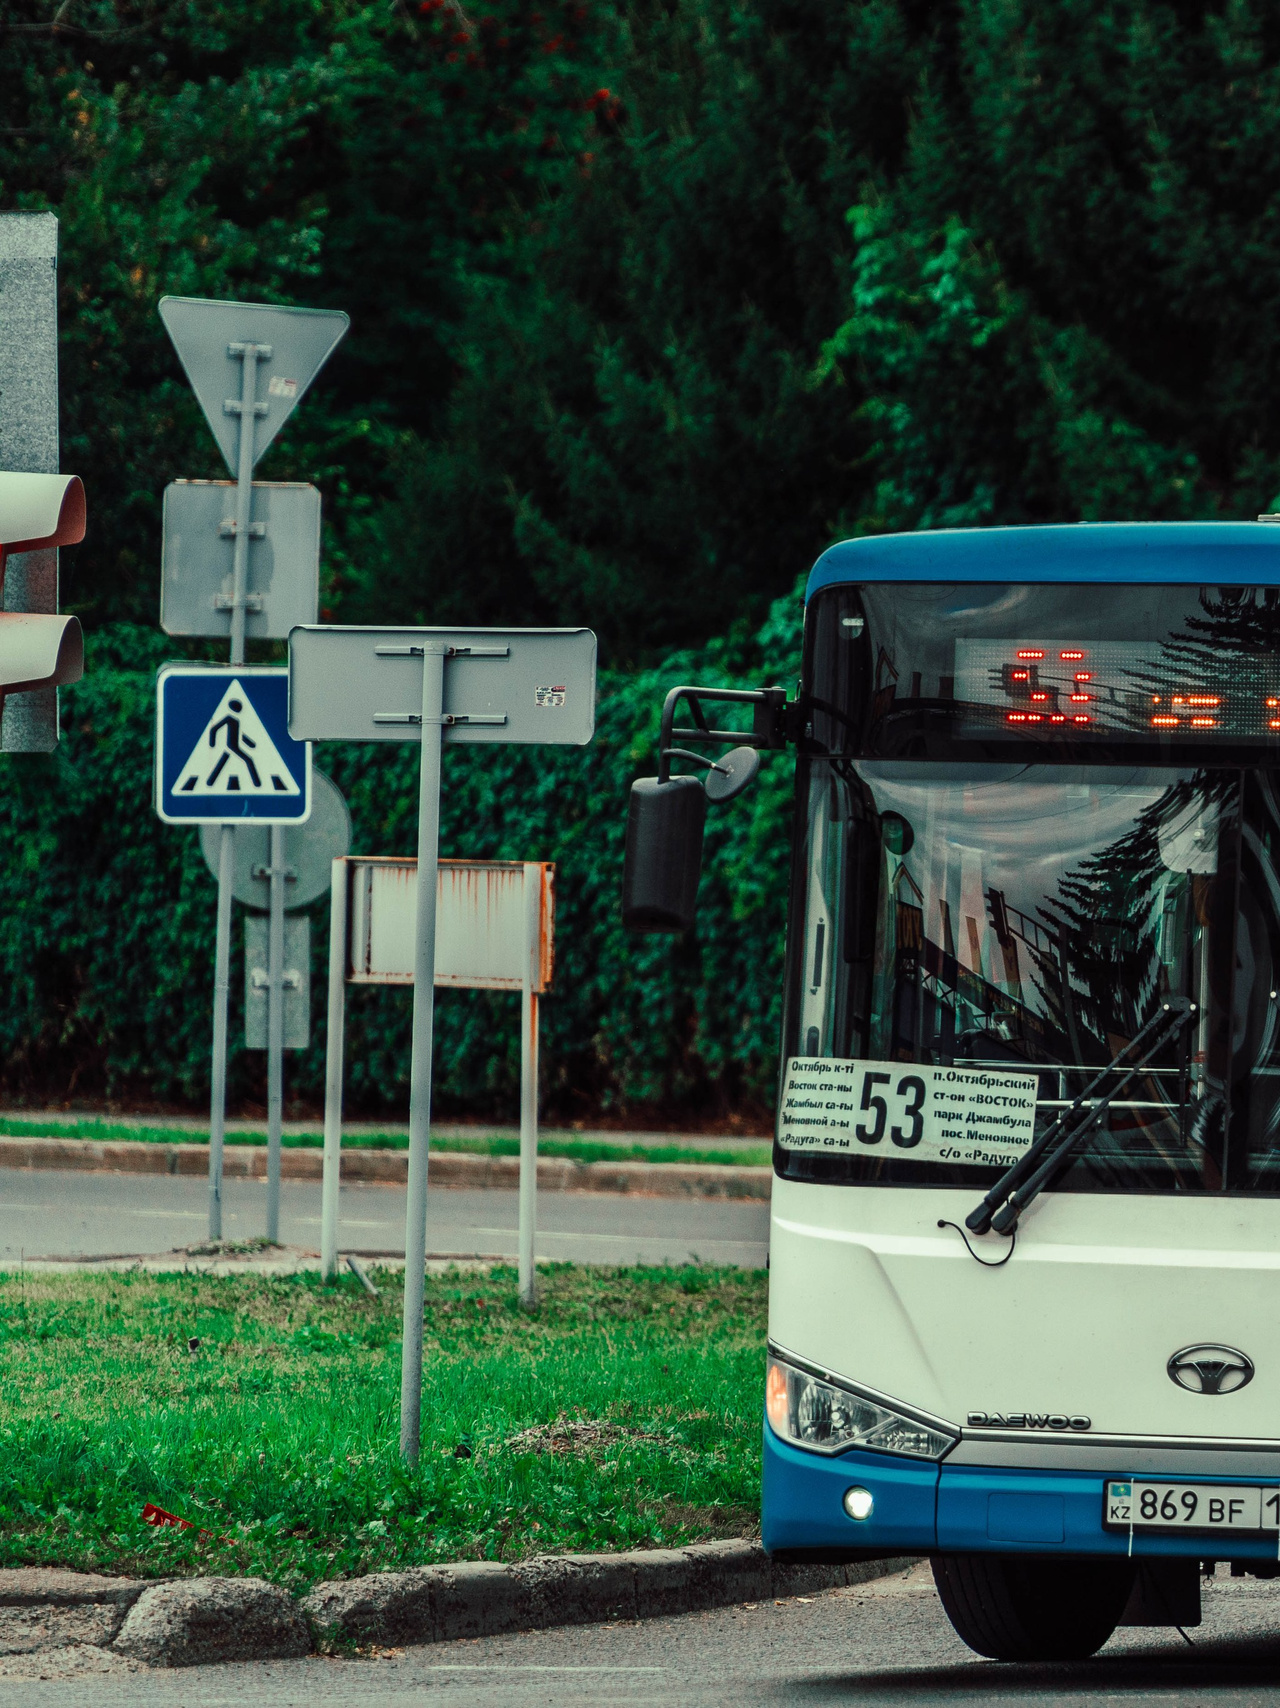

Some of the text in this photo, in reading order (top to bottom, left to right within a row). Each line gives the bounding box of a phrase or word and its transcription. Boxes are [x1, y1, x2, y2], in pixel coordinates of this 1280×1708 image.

[792, 1061, 832, 1075] Октябрь
[789, 1080, 853, 1093] Восток ста-ны
[933, 1071, 1036, 1091] п.Октябрьский
[786, 1098, 823, 1109] Жамбыл
[933, 1091, 1034, 1109] ст-он «ВОСТОК»
[855, 1071, 927, 1149] 53
[933, 1110, 1032, 1129] парк Джамбула
[780, 1133, 850, 1148] «Радуга» са-ы
[941, 1129, 1030, 1145] пос.Меновное
[939, 1147, 1020, 1166] с/о «Радуга
[967, 1411, 1092, 1431] DAEWOO
[1109, 1505, 1131, 1520] KZ
[1139, 1488, 1199, 1522] 869
[1208, 1498, 1245, 1523] BF
